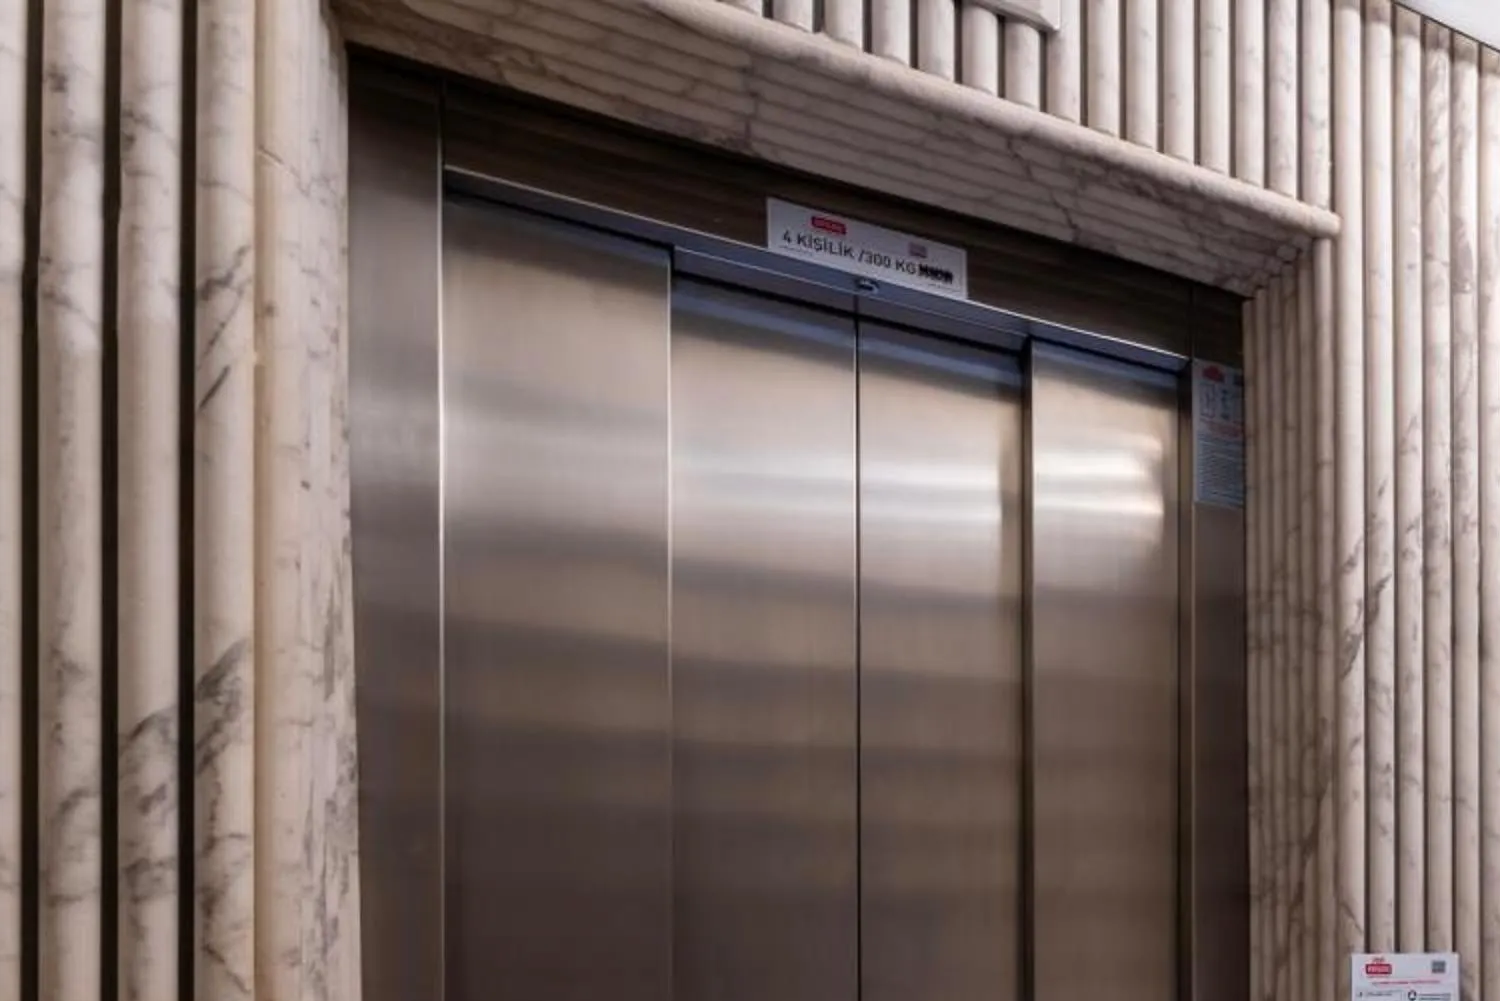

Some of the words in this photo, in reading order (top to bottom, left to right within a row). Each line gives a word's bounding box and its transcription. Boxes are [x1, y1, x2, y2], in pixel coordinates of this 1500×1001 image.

[782, 229, 792, 244] 4
[857, 249, 891, 269] /300
[895, 260, 917, 276] KG
